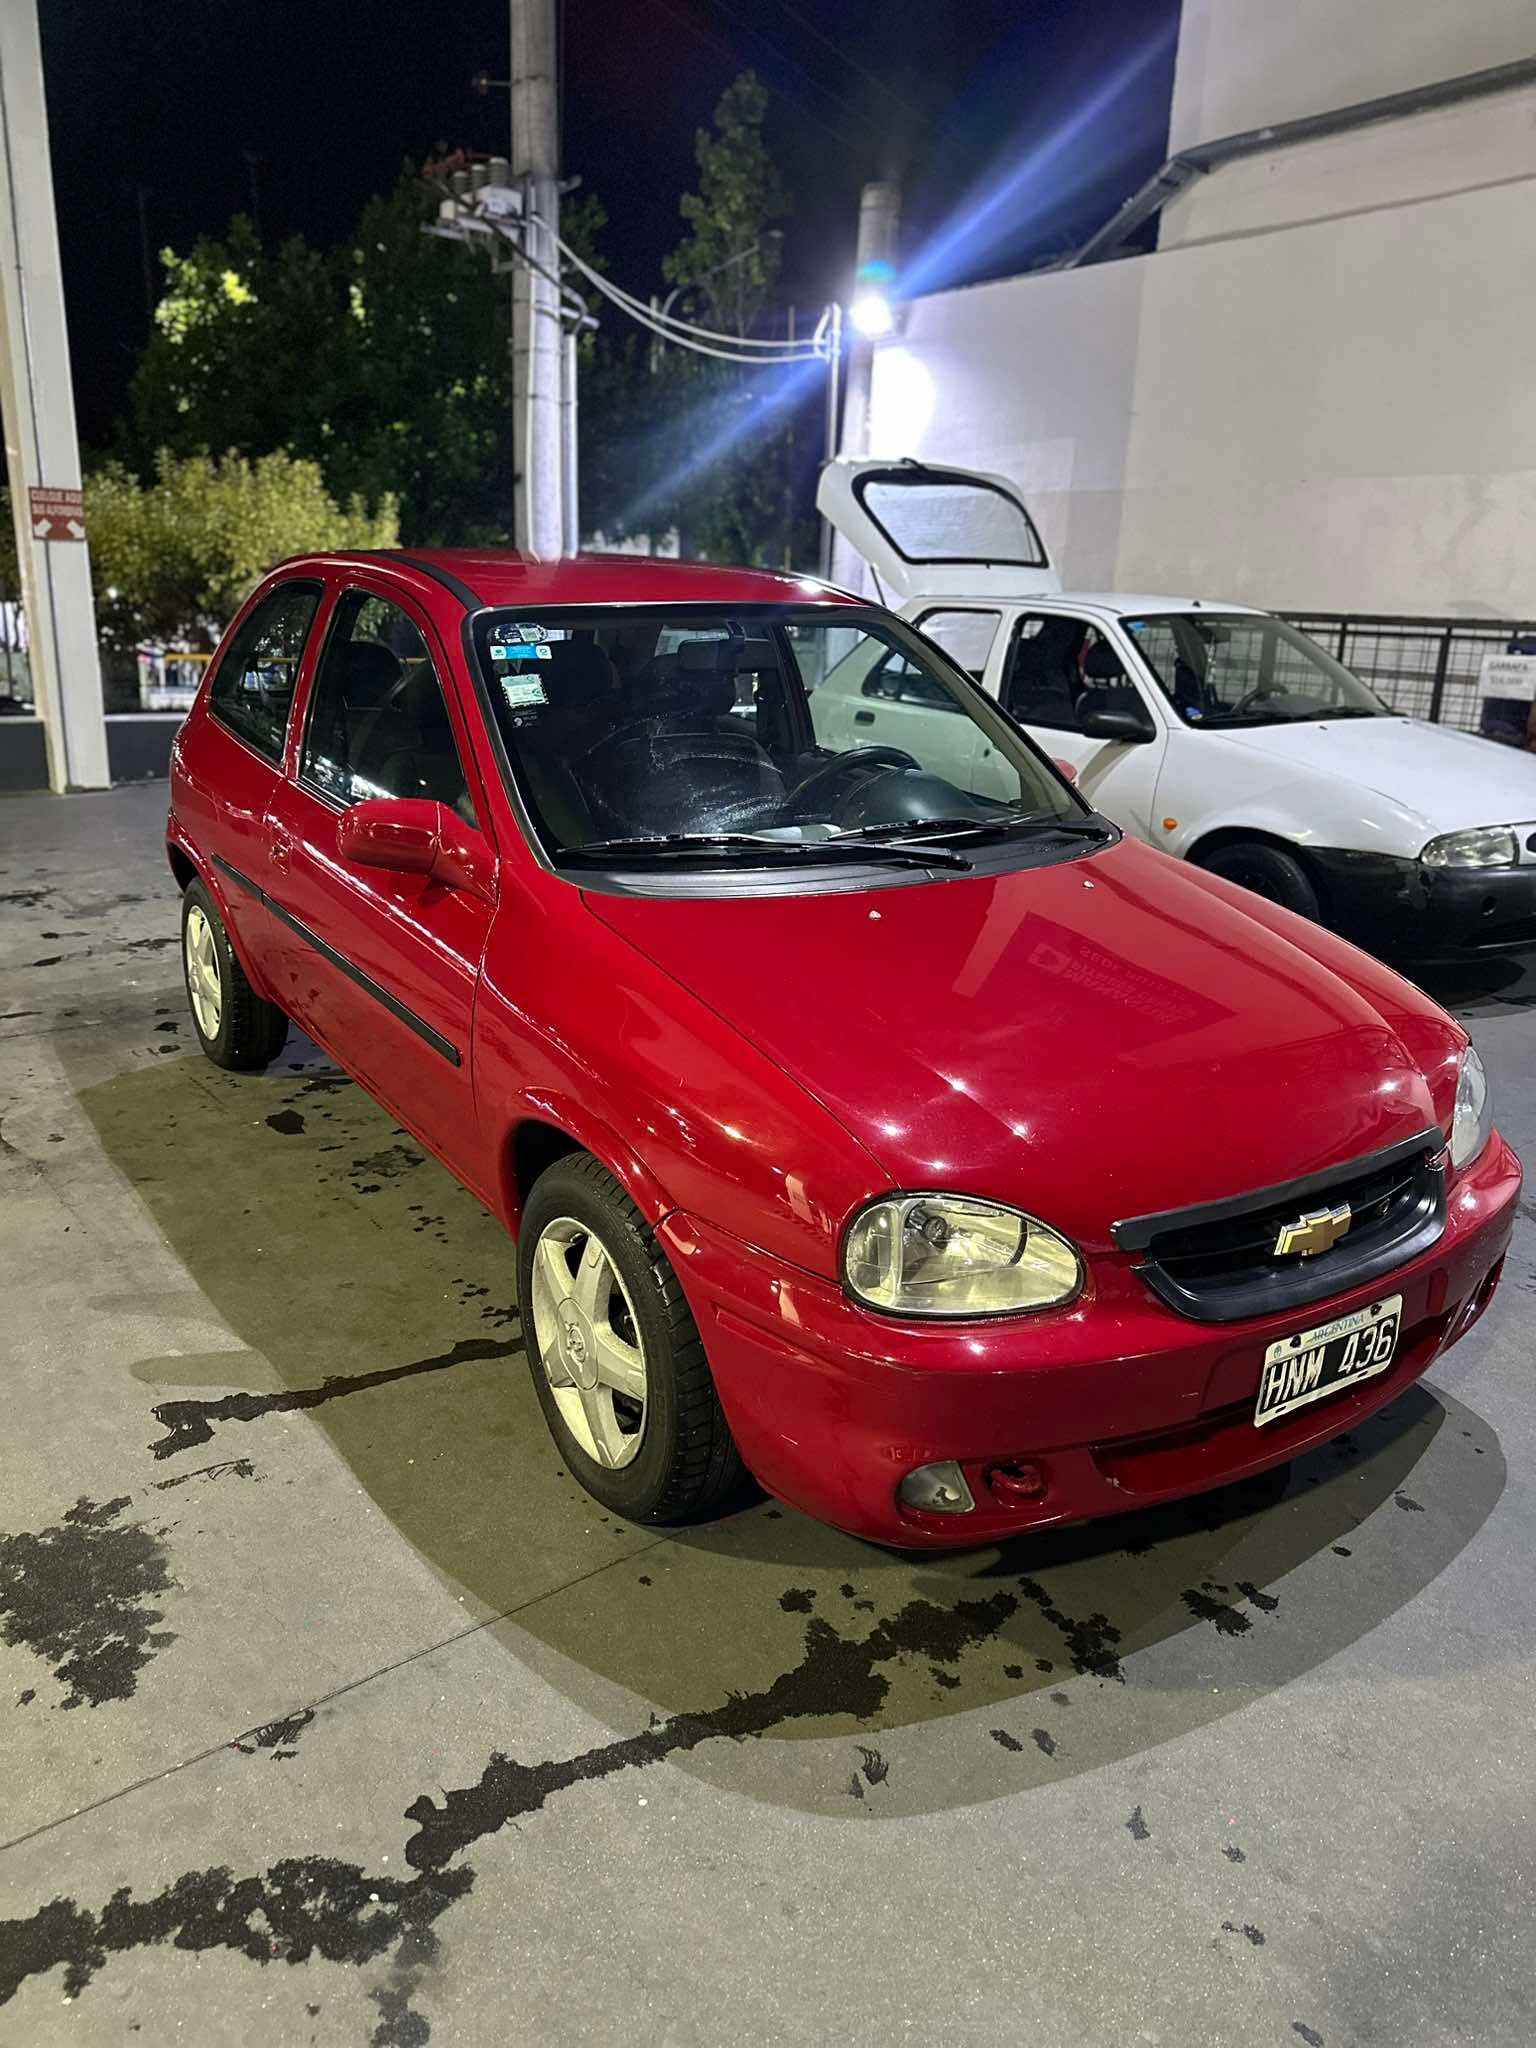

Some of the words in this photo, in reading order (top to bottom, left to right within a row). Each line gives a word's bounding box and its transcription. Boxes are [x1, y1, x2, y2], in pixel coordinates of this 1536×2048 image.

[1311, 1314, 1364, 1341] ARGENTINA
[1263, 1345, 1326, 1410] HNM
[1338, 1318, 1394, 1374] 436
